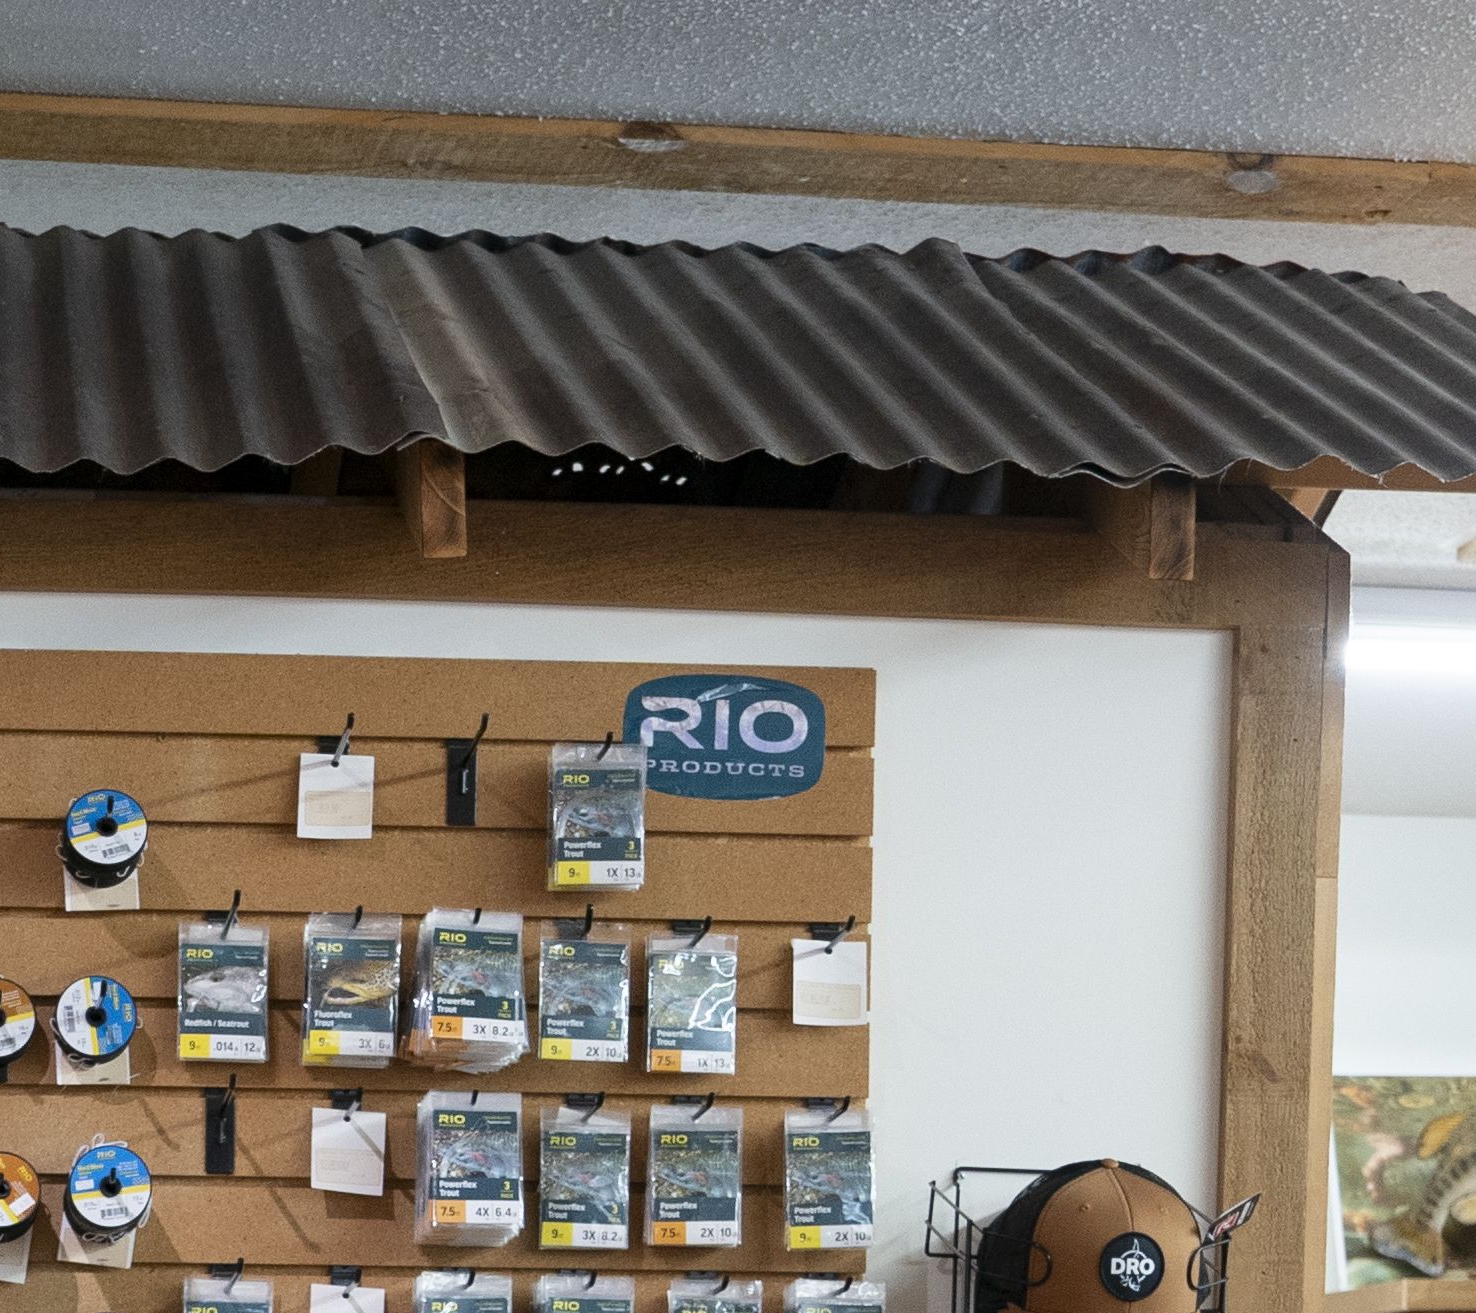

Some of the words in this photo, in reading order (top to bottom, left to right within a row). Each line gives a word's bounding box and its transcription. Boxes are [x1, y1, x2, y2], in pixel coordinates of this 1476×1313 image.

[640, 695, 809, 753] RIO
[562, 774, 590, 784] RIO
[564, 841, 601, 850] Powerflex
[564, 850, 584, 858] Trout
[439, 931, 467, 943] RIO
[317, 942, 343, 953] RIO
[186, 948, 213, 959] RIO
[314, 1010, 352, 1019] Fluoroflex
[184, 1018, 209, 1028] Redfish
[314, 1018, 335, 1028] Trout
[1111, 1258, 1155, 1275] DRO
